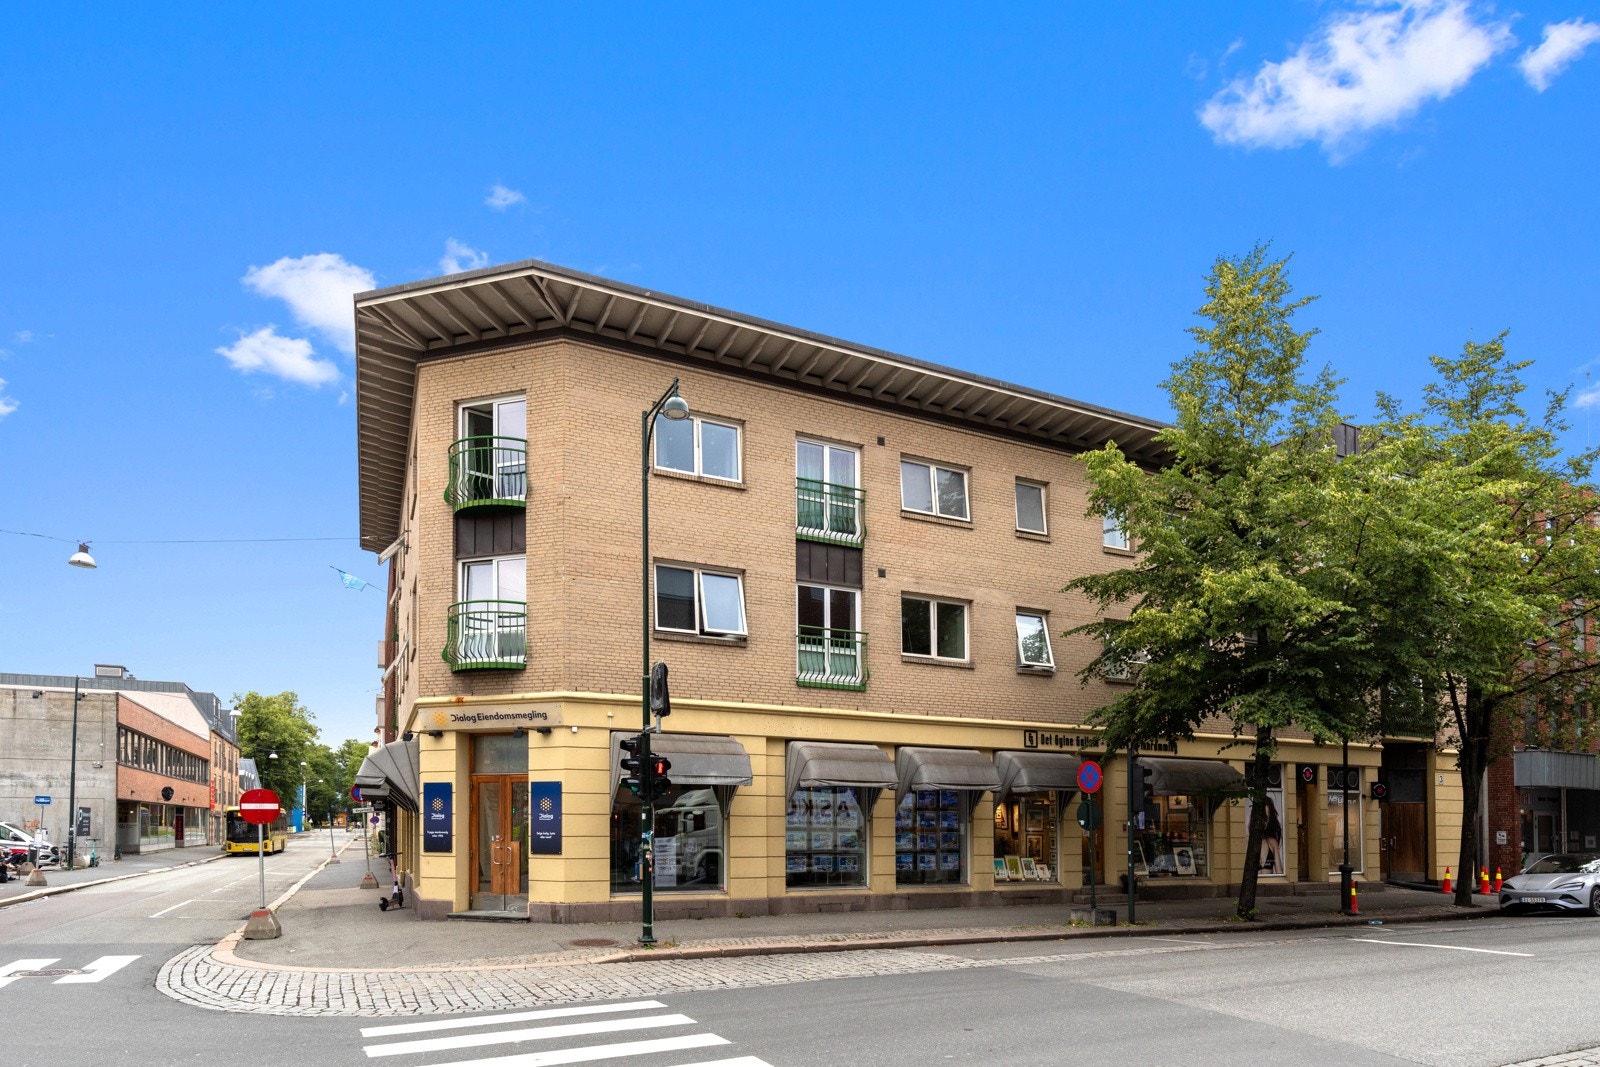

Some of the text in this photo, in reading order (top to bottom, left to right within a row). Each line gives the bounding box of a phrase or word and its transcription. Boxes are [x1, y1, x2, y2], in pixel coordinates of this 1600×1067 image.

[450, 710, 548, 724] Dialog Eiendomsmegling
[1041, 733, 1053, 746] Det
